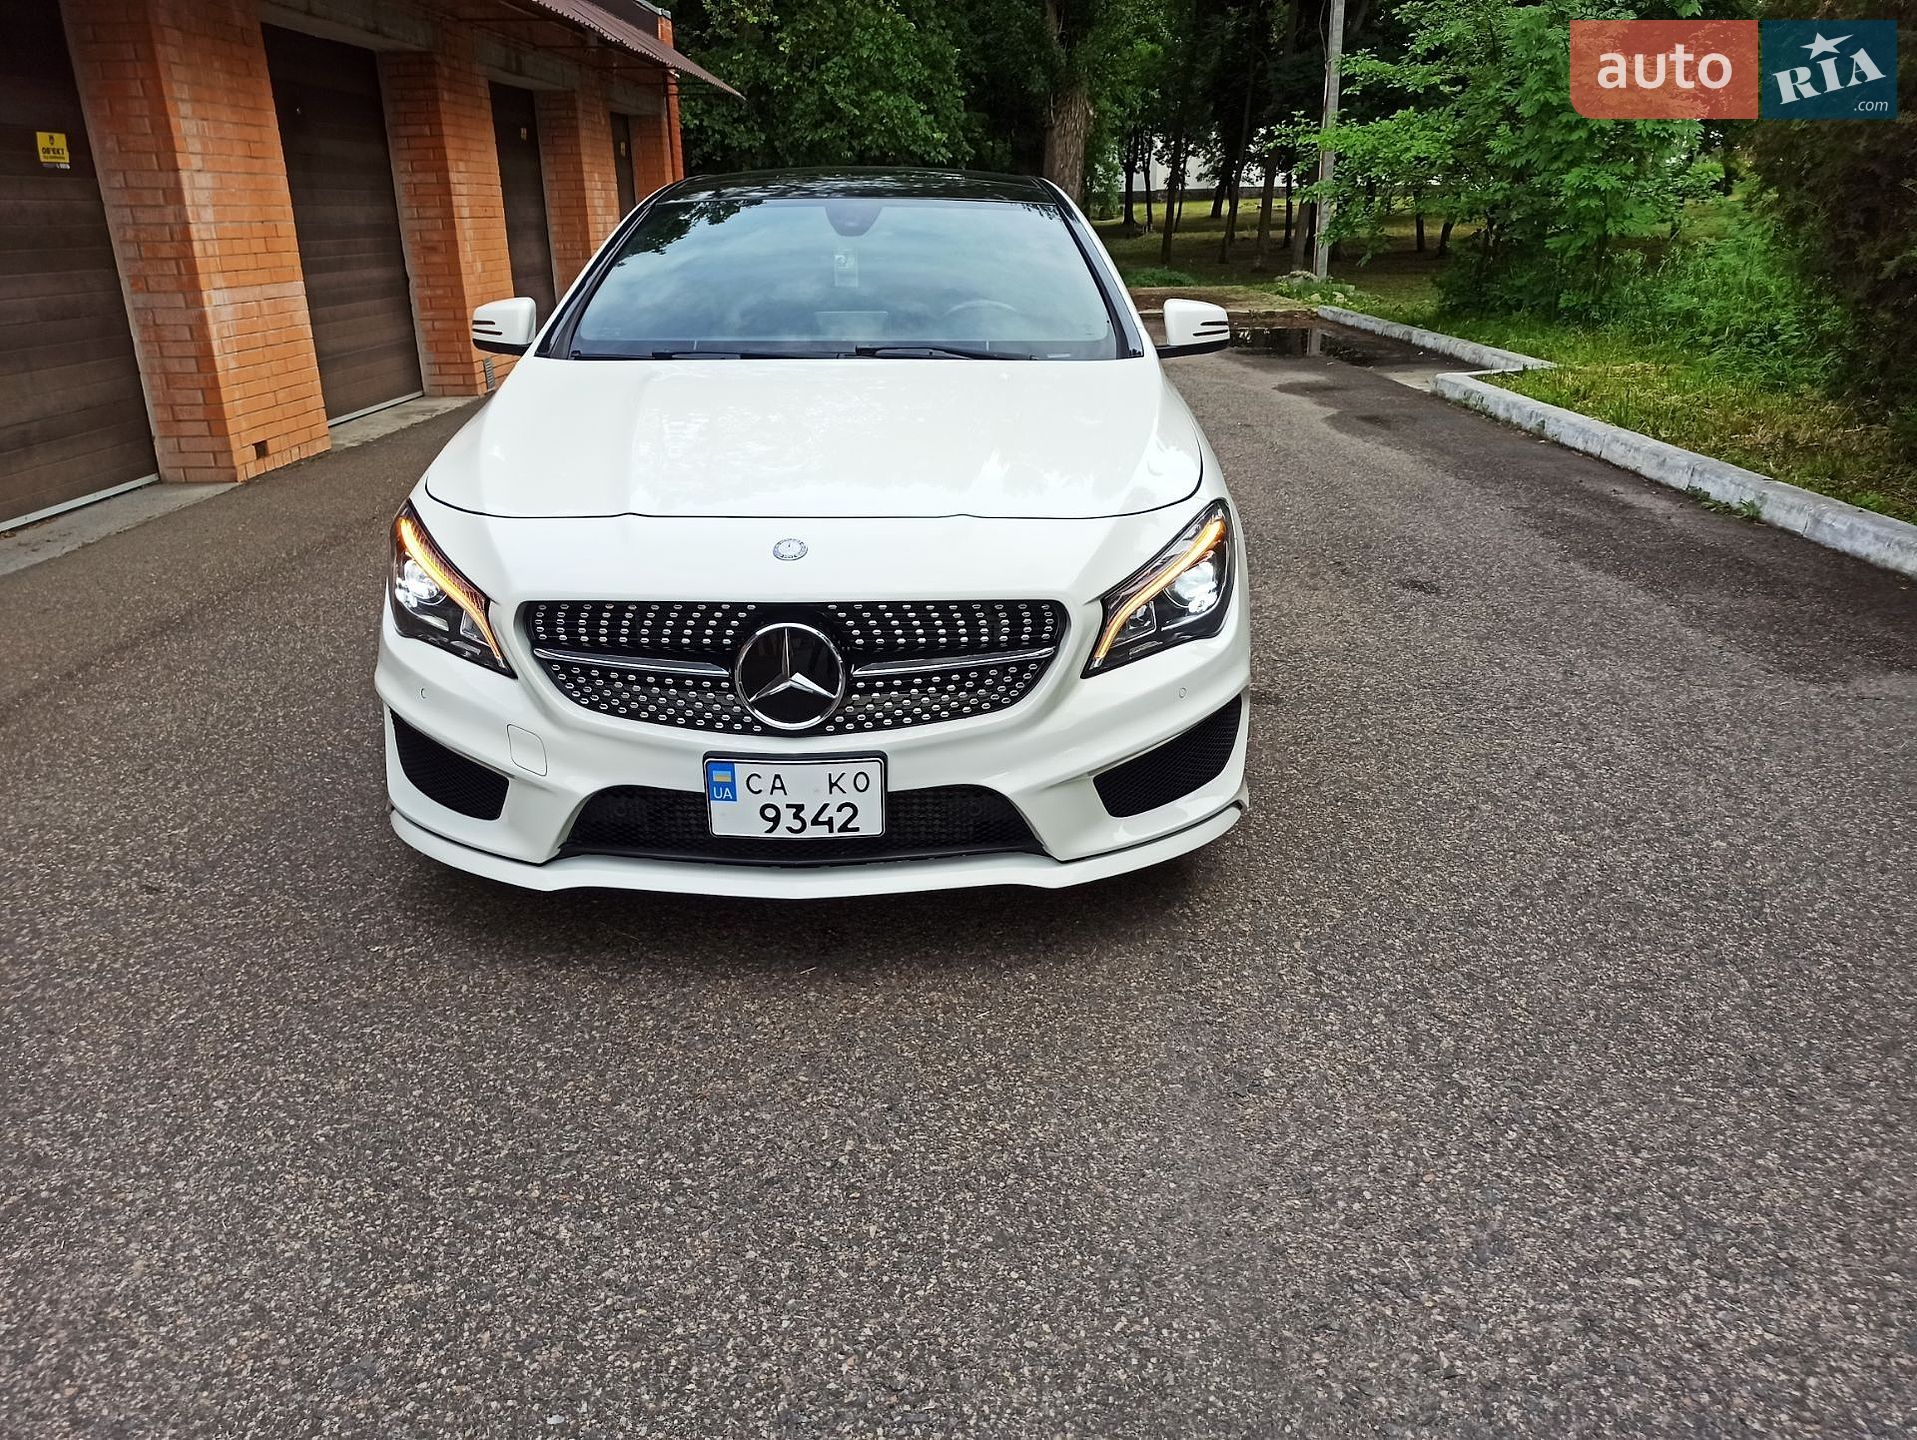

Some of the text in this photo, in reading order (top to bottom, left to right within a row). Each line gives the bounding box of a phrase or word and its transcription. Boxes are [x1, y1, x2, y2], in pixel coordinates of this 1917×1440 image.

[713, 787, 733, 799] UA
[746, 771, 870, 795] CA KO
[759, 801, 860, 834] 9342
